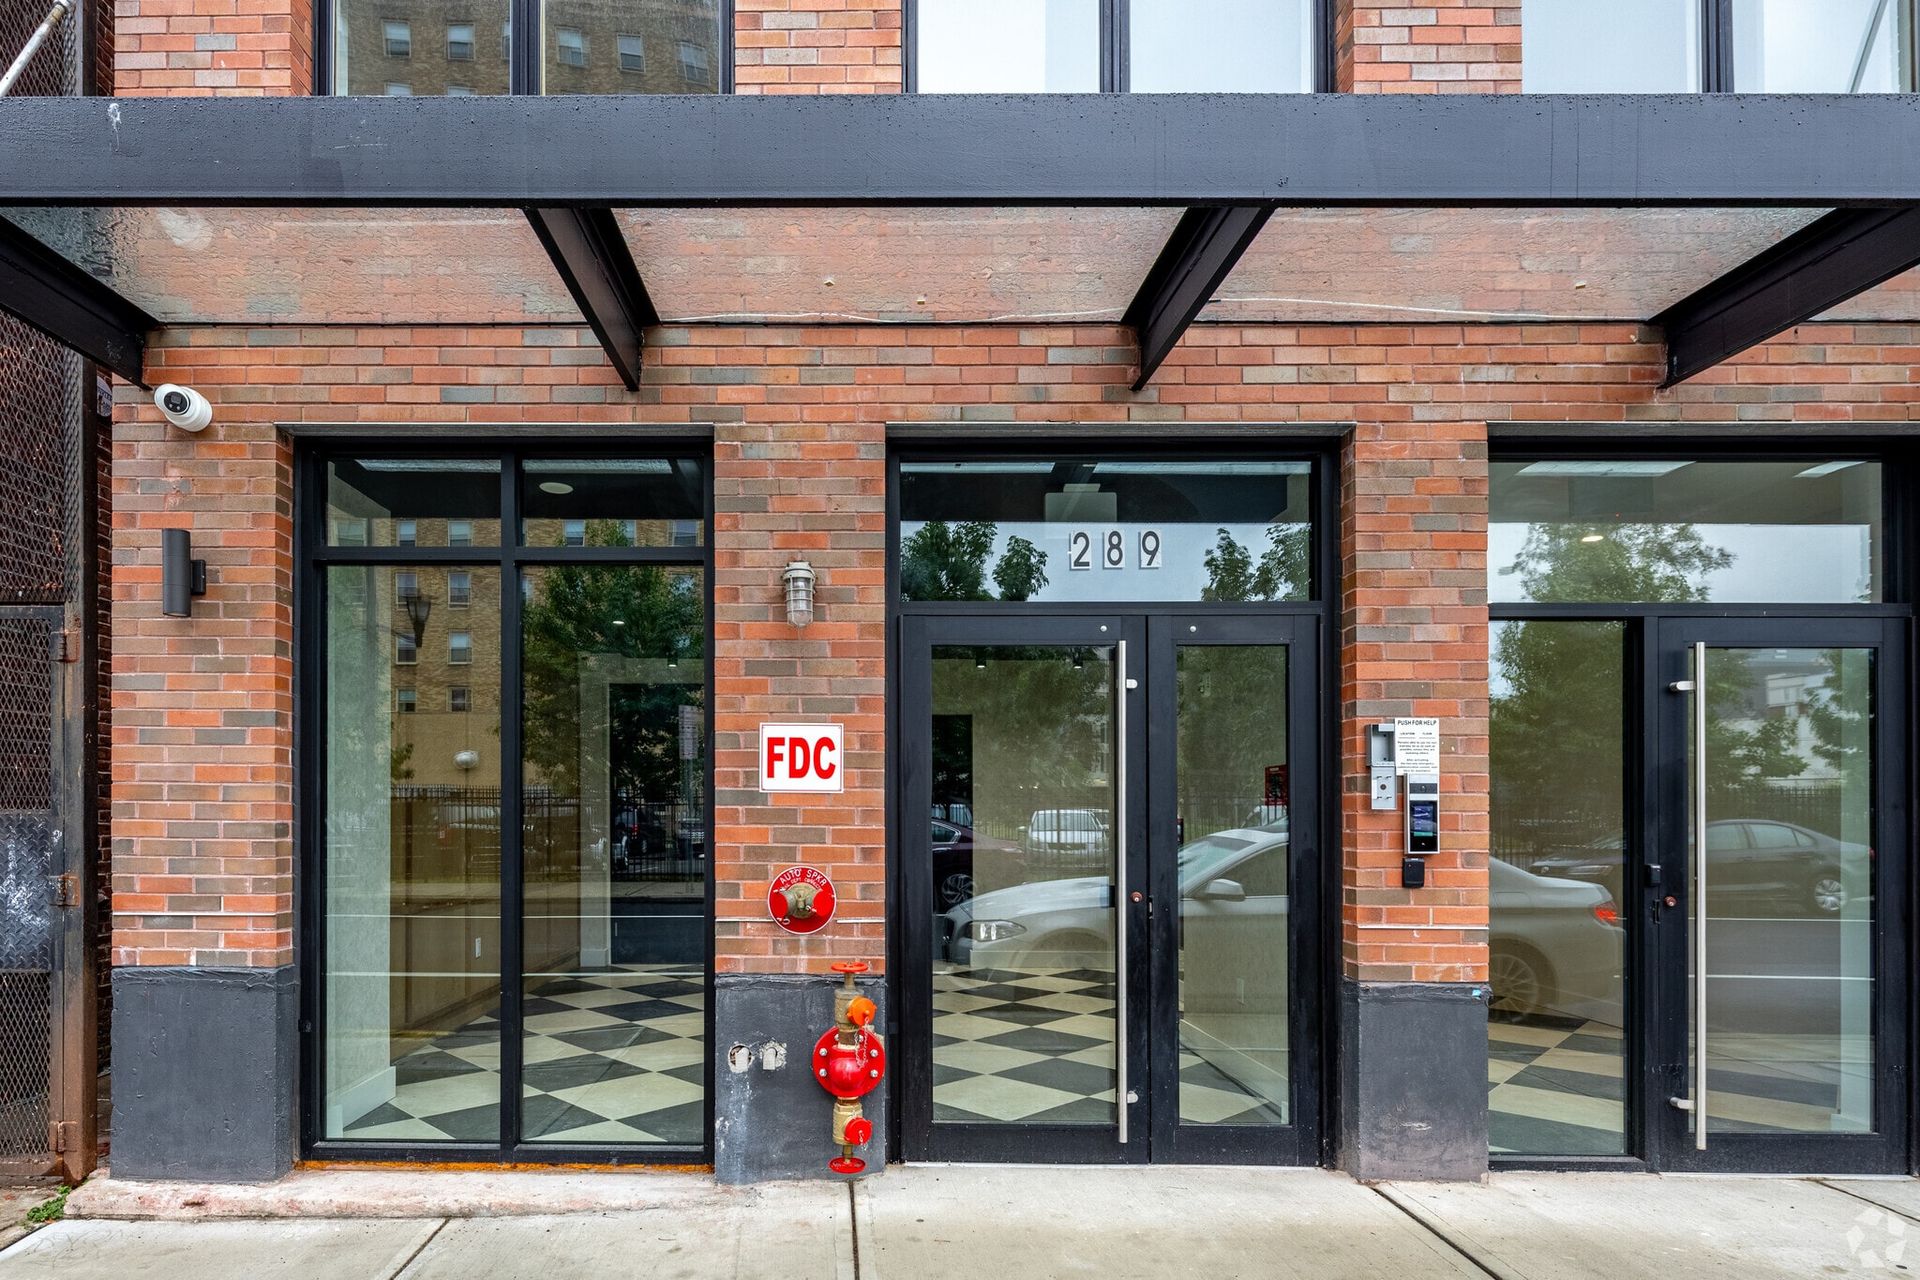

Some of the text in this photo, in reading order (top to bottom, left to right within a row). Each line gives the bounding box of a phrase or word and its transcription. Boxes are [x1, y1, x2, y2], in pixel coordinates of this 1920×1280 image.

[1073, 531, 1160, 567] 289
[767, 737, 836, 779] FDC
[780, 868, 801, 885] AUTO
[806, 869, 827, 887] SPKR
